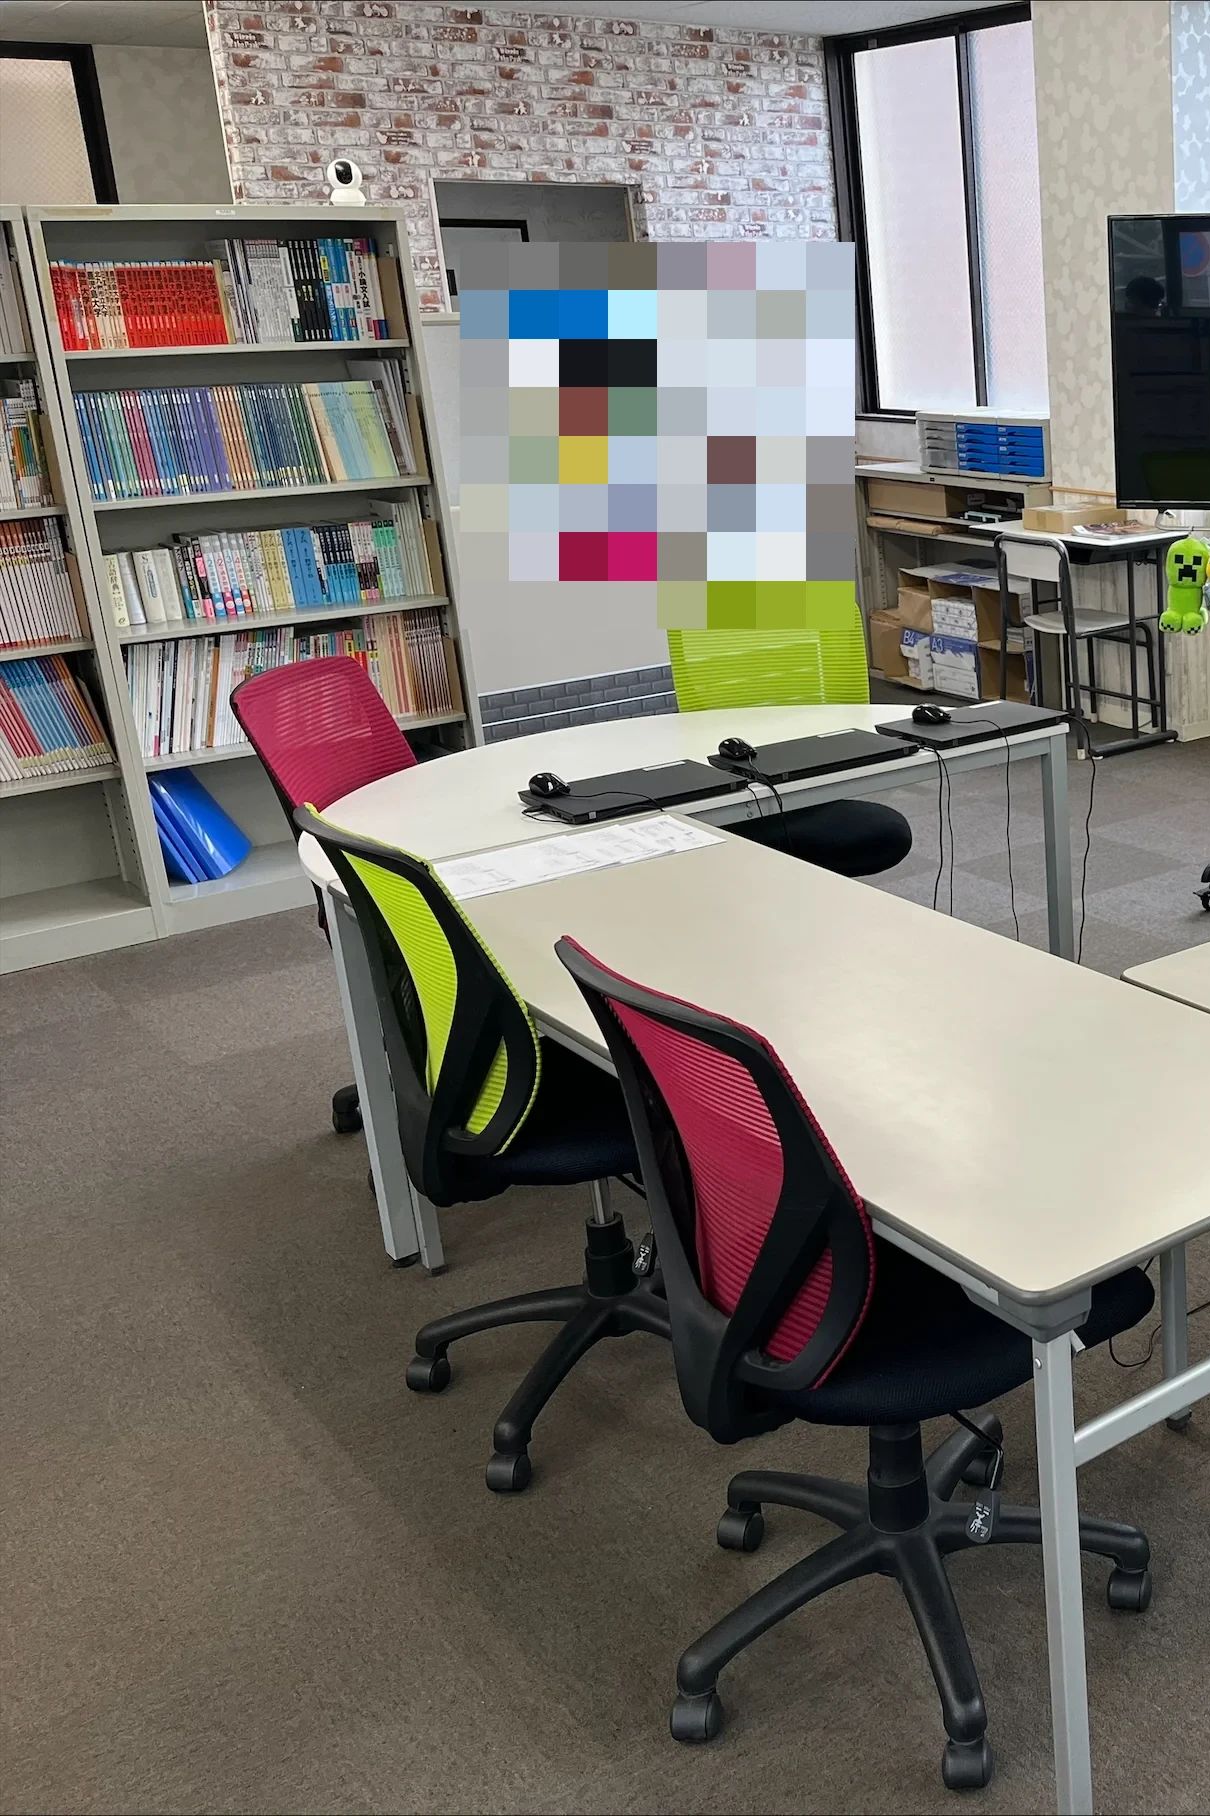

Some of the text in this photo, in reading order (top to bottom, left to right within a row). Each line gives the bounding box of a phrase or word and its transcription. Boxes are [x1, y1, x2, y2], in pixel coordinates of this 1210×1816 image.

[358, 272, 371, 308] 小論文入試
[903, 630, 915, 645] B4
[931, 638, 943, 652] A3
